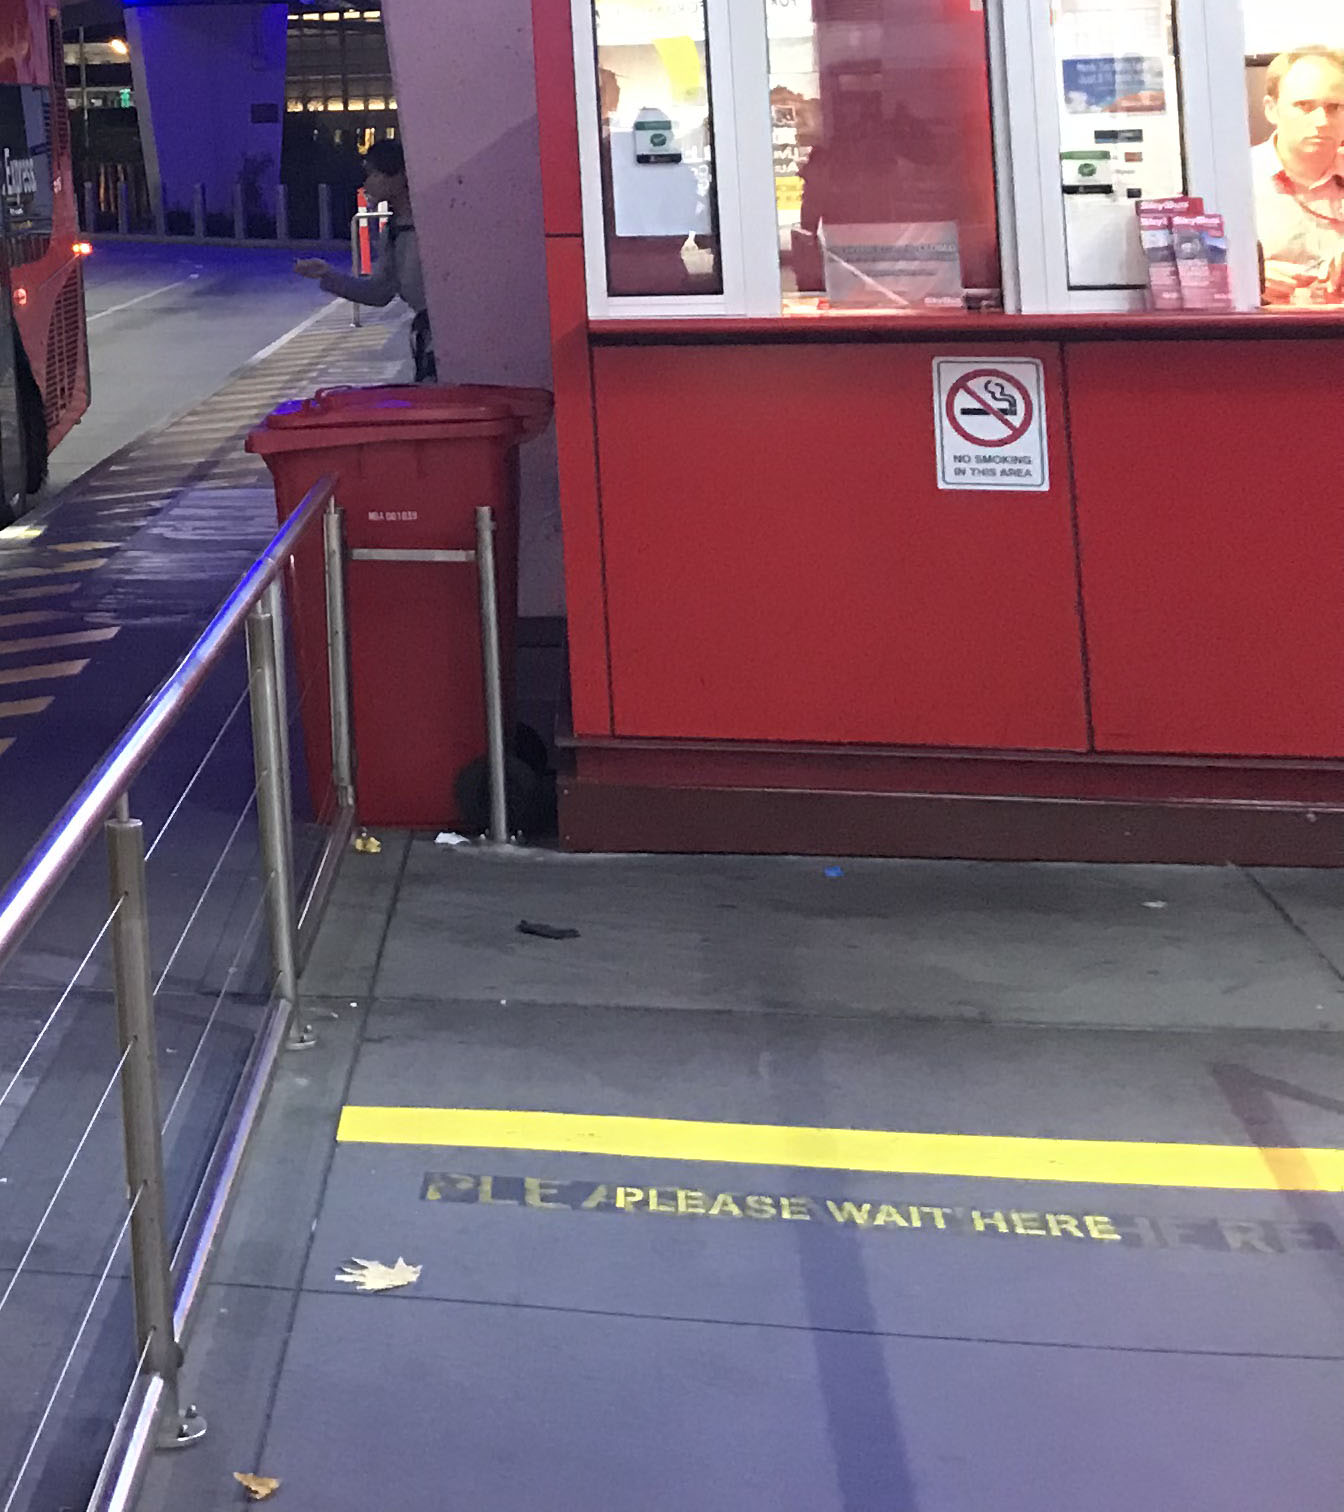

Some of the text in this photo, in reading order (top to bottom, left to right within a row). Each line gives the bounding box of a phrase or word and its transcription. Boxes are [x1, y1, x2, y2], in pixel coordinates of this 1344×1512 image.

[953, 455, 1032, 465] NO SMOKING
[954, 468, 1032, 477] IN THIS AREA
[615, 1186, 1121, 1241] PLEASE WAIT HERE
